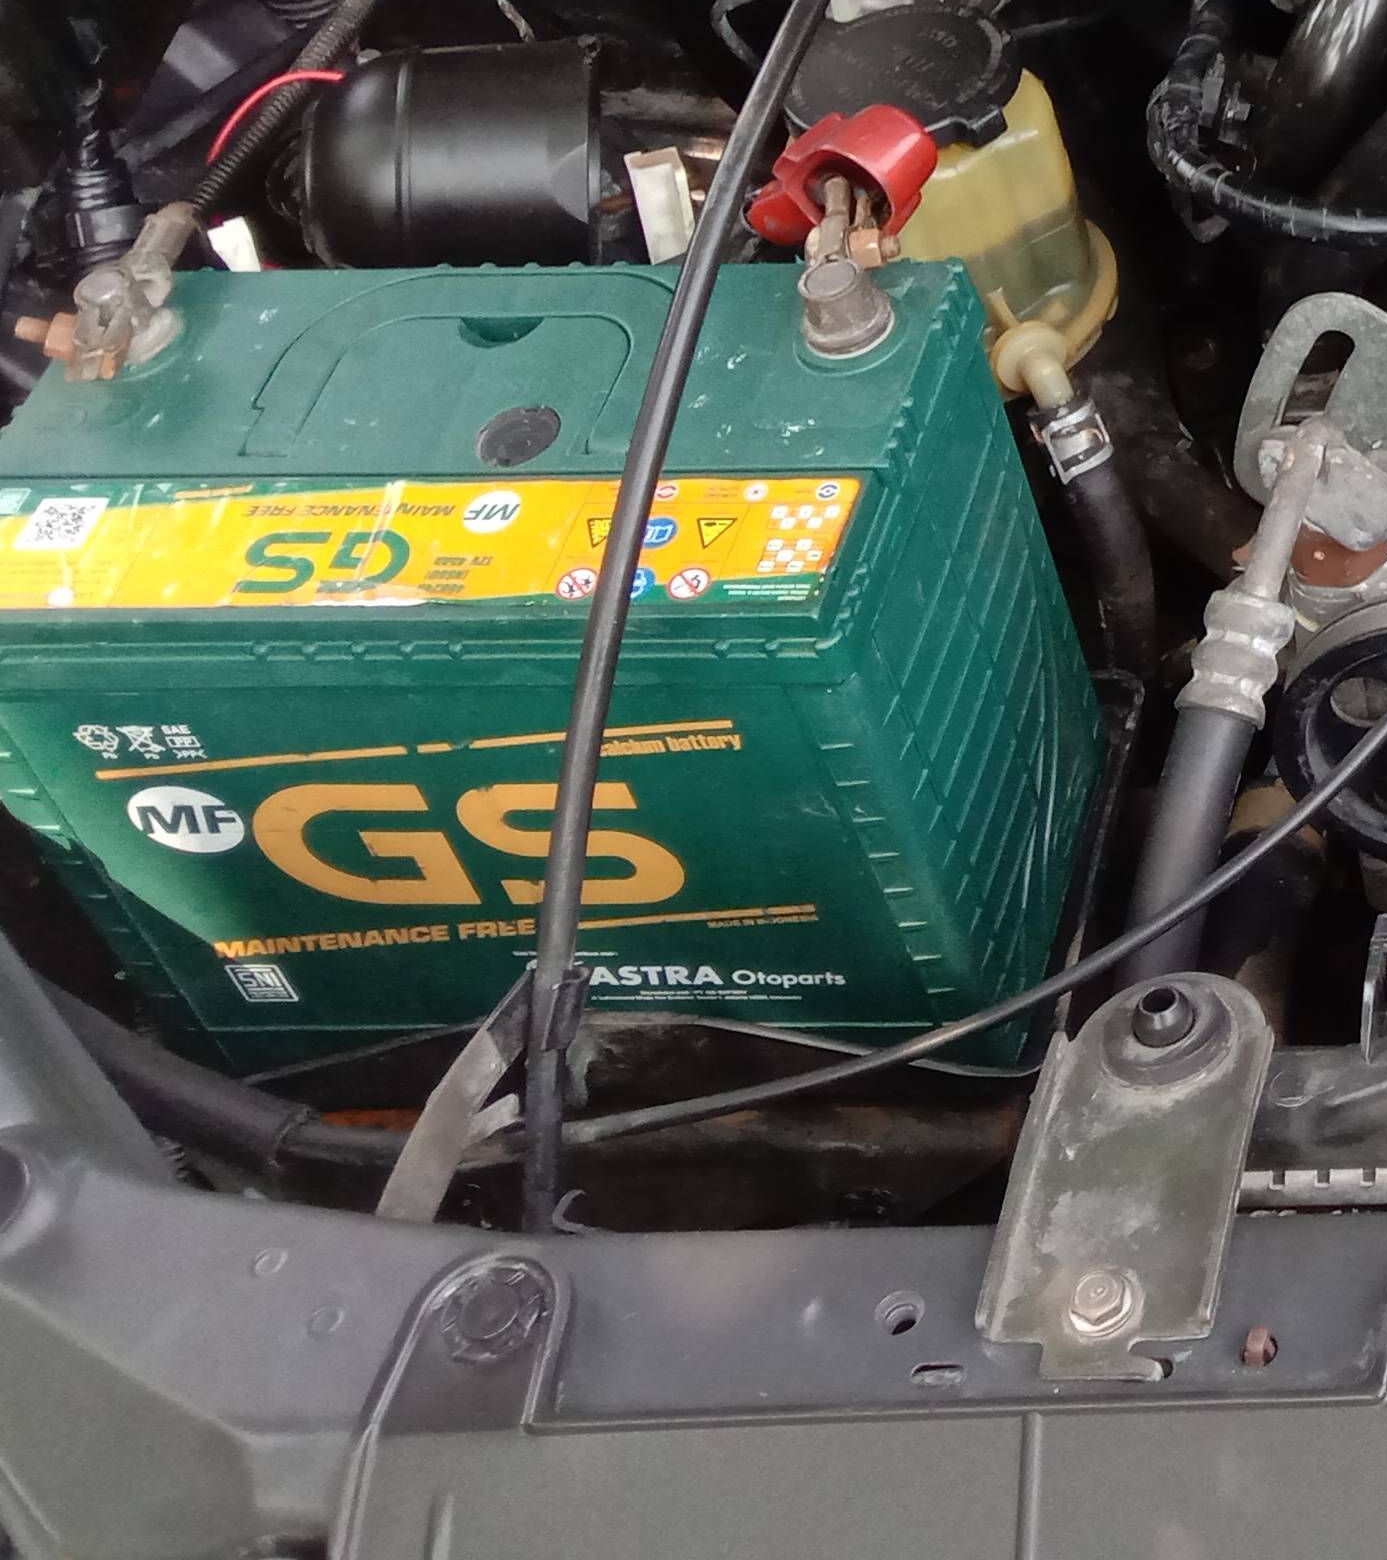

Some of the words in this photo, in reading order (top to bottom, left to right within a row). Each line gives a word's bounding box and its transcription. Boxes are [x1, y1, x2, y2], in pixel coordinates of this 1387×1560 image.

[242, 505, 298, 517] FREE
[464, 503, 519, 520] MF
[231, 530, 410, 593] GS
[160, 724, 192, 735] SAE
[665, 734, 742, 753] battery
[136, 804, 237, 834] MF
[252, 782, 686, 906] GS
[213, 924, 449, 958] MAINTENANCE
[457, 918, 537, 940] FREE
[237, 972, 282, 988] SNI
[587, 965, 724, 986] ASTRA
[731, 968, 847, 990] Otoparts
